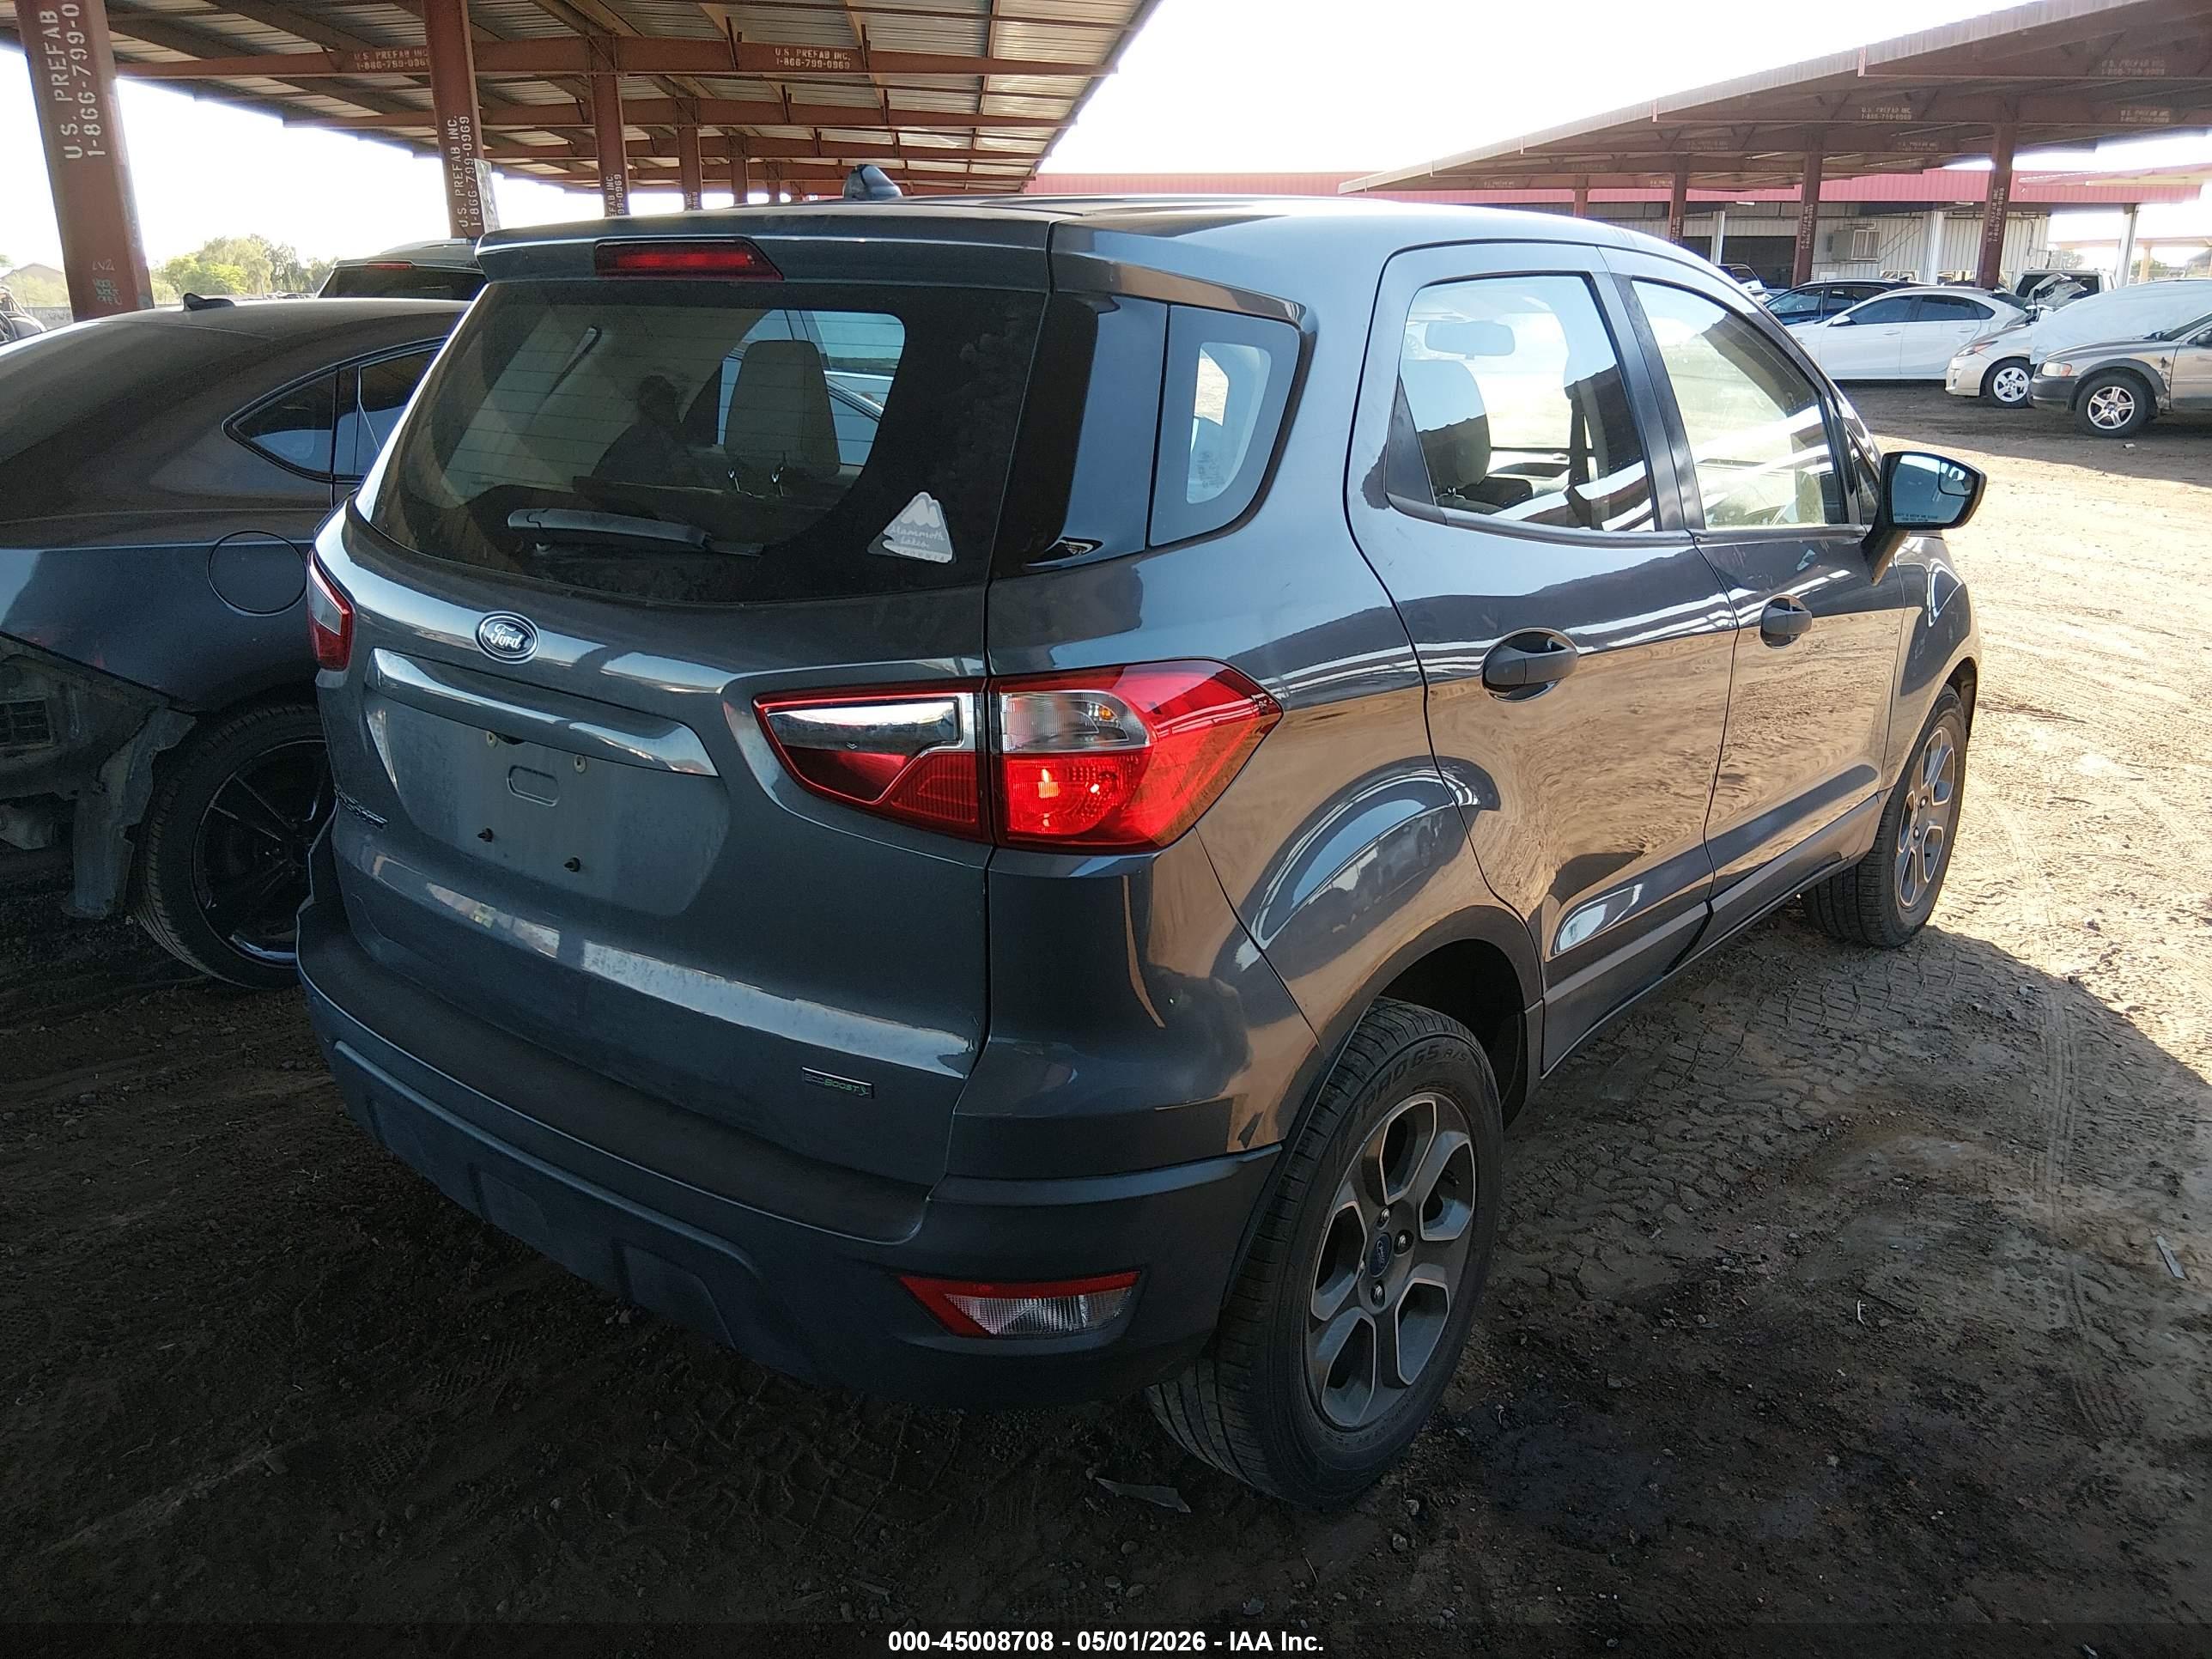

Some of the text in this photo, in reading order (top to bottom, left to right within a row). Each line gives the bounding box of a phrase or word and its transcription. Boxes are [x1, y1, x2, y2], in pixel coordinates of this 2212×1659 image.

[375, 50, 410, 59] PREFAB
[796, 49, 830, 59] PREFAB
[834, 52, 851, 61] INC.
[40, 10, 83, 159] U.S. PREFAB
[447, 116, 469, 228] U.S. PREFAB INC.
[605, 173, 615, 191] INC.
[490, 623, 524, 648] Ford
